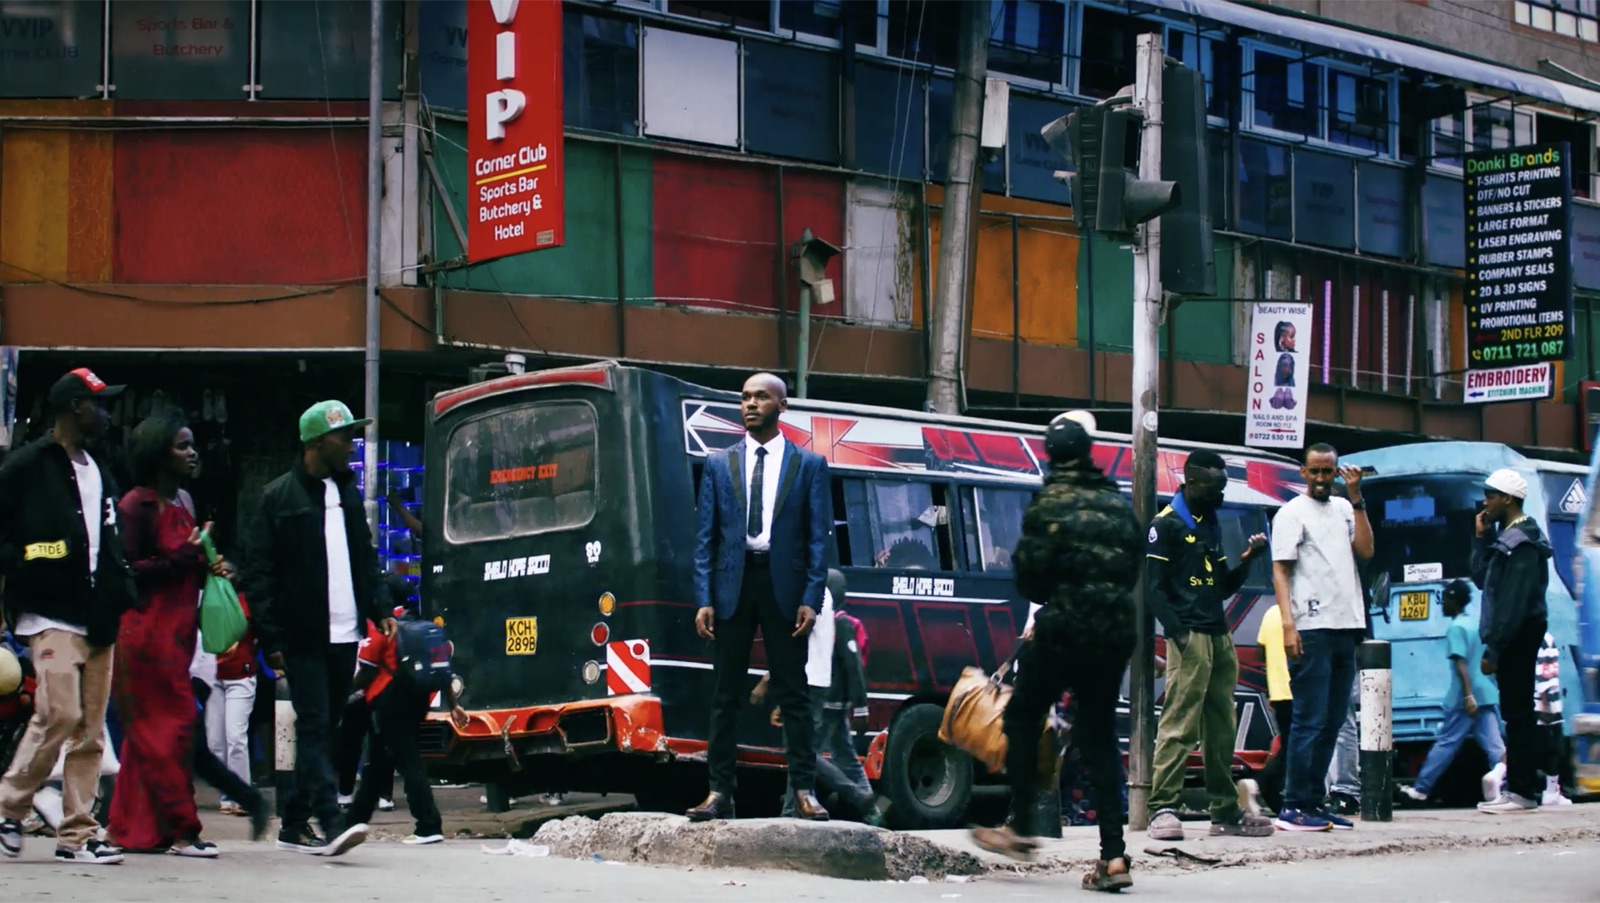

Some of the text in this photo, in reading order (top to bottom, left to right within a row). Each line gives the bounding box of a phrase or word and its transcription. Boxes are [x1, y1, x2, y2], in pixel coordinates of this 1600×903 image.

[136, 17, 235, 33] Sports Bar &
[153, 43, 223, 57] Butchery
[475, 143, 547, 176] Corner Club
[1509, 147, 1560, 168] Brands
[1477, 166, 1561, 187] T-SHIRTS PRINTING
[480, 176, 539, 203] Sports Bar
[1477, 184, 1531, 202] DTF/NO CUT
[479, 194, 542, 222] Butchery &
[1476, 196, 1562, 217] BANNERS & STICKERS
[494, 221, 524, 241] Hotel
[1477, 213, 1549, 233] LARGE FORMAT
[1477, 235, 1507, 249] LASER
[1508, 229, 1562, 246] ENGRAVING
[1478, 246, 1553, 265] RUBBER STAMPS
[1478, 262, 1555, 281] COMPANY SEALS
[1479, 279, 1547, 297] 2D & 3D SIGNS
[1258, 306, 1306, 315] BEAUTY WISE
[1480, 297, 1537, 314] UV PRINTING
[1480, 310, 1564, 329] PROMOTIONAL ITEMS
[1501, 324, 1564, 341] 2ND FLR 209
[1483, 340, 1564, 361] 0711 721 087
[1252, 332, 1265, 410] SALON
[1467, 366, 1547, 389] EMBROIDERY
[1487, 385, 1545, 398] STITCHING MACHINE
[538, 463, 559, 479] EXIT
[1407, 592, 1426, 606] KBU
[1402, 605, 1425, 618] 126V
[509, 620, 532, 636] KCH
[507, 636, 536, 651] 289B
